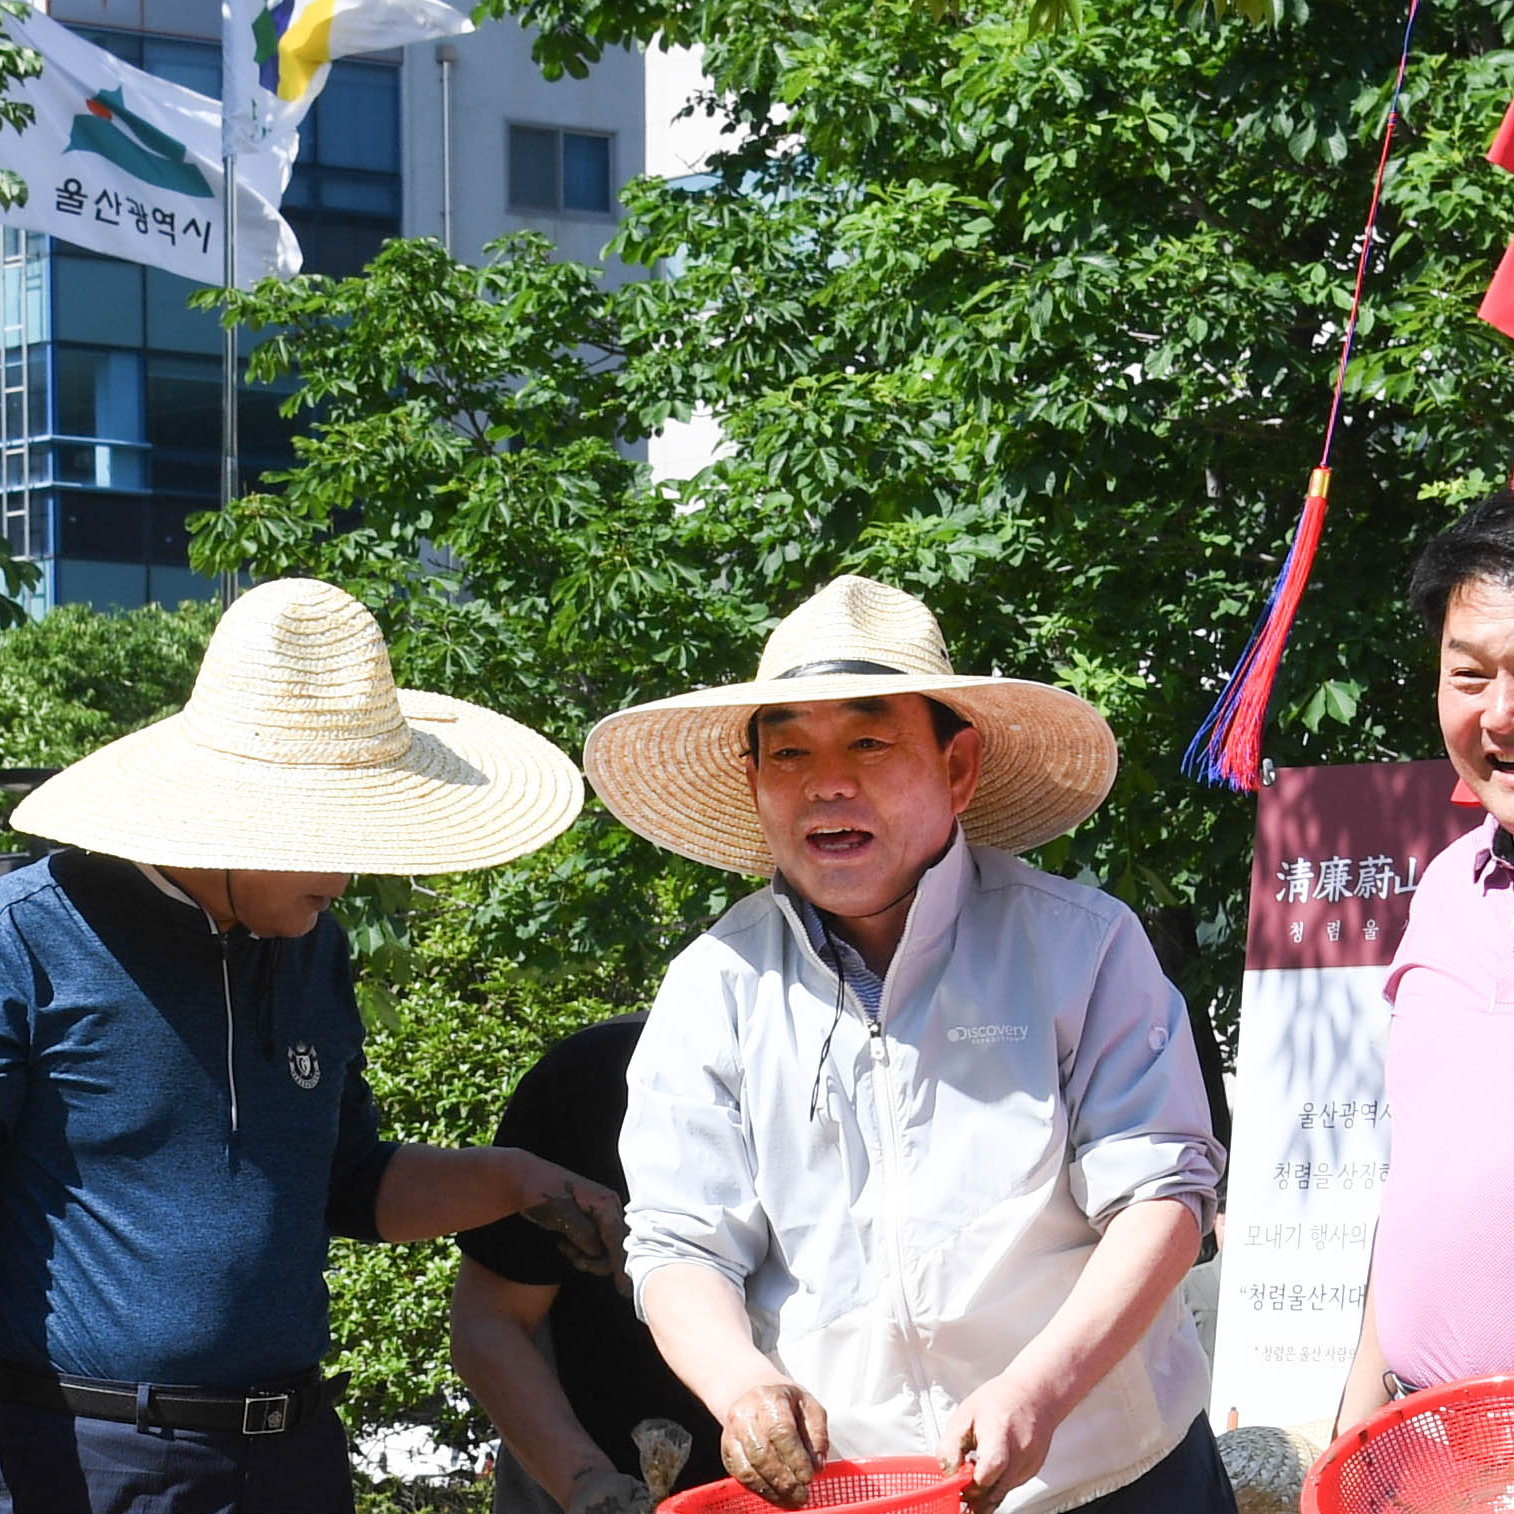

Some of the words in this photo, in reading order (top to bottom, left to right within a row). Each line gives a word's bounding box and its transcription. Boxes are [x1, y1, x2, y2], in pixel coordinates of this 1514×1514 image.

[55, 178, 211, 254] 울산광역시
[1273, 1161, 1333, 1191] 청렴을
[1245, 1223, 1302, 1249] 모내기
[1310, 1223, 1367, 1251] 행사의
